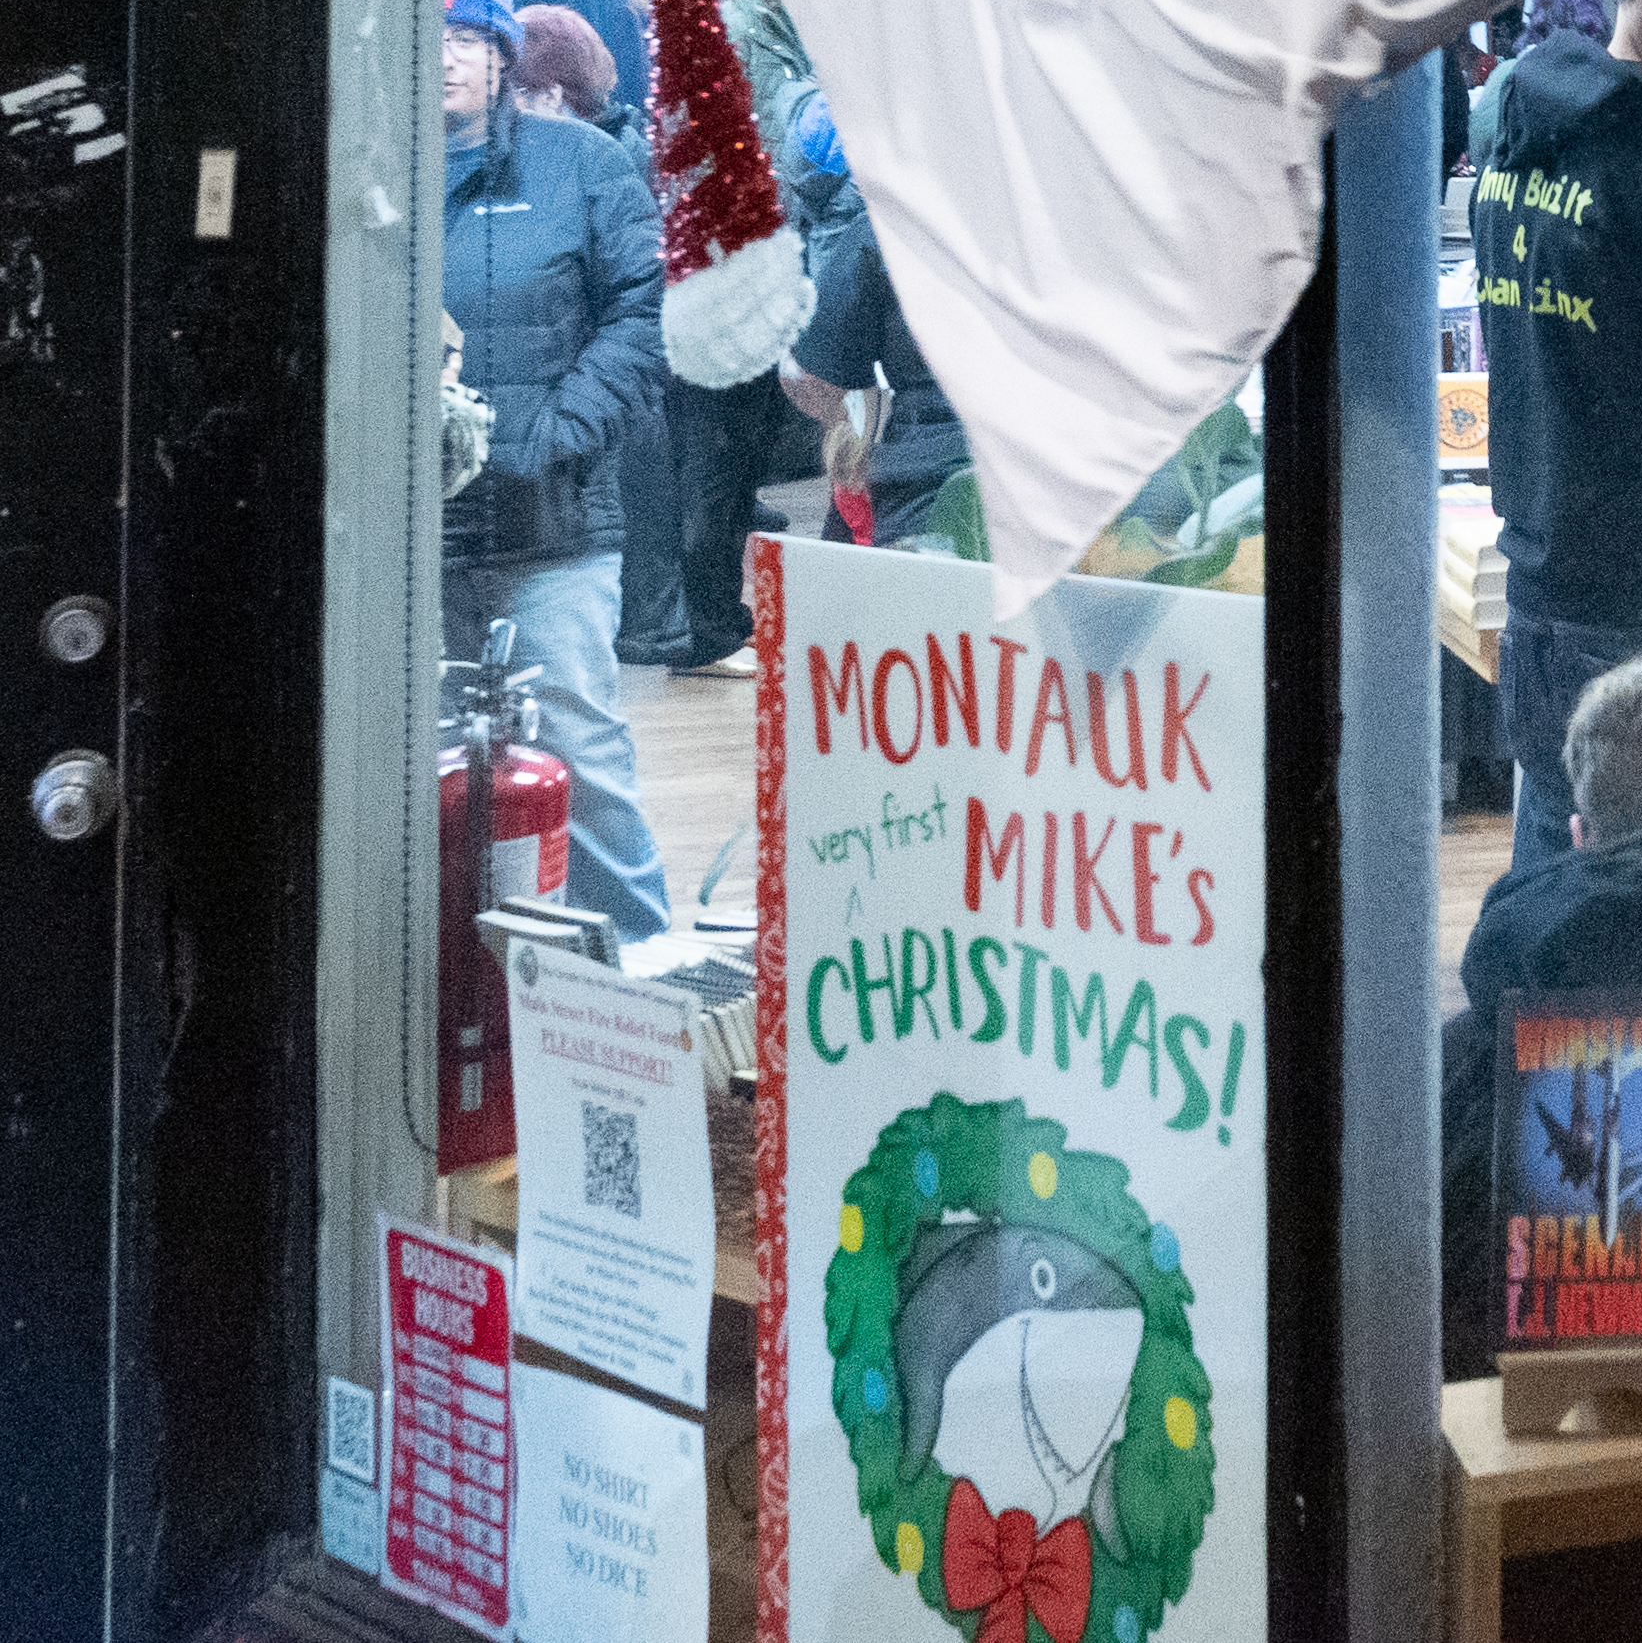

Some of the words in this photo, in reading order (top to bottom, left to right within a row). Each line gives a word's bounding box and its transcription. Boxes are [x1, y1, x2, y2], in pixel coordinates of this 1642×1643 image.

[1524, 167, 1594, 227] Built
[1512, 224, 1528, 263] 4
[807, 633, 1212, 792] MONTAUK
[808, 816, 876, 880] very
[880, 785, 948, 846] first
[540, 1028, 596, 1060] PLEASE
[807, 926, 1248, 1147] CHRISTMAS!
[400, 1240, 489, 1306] BUSINESS
[413, 1286, 475, 1345] HOURS
[593, 1464, 650, 1511] SHIRT
[559, 1494, 589, 1529] NO
[592, 1506, 659, 1558] SHOES
[597, 1554, 649, 1598] DICE
